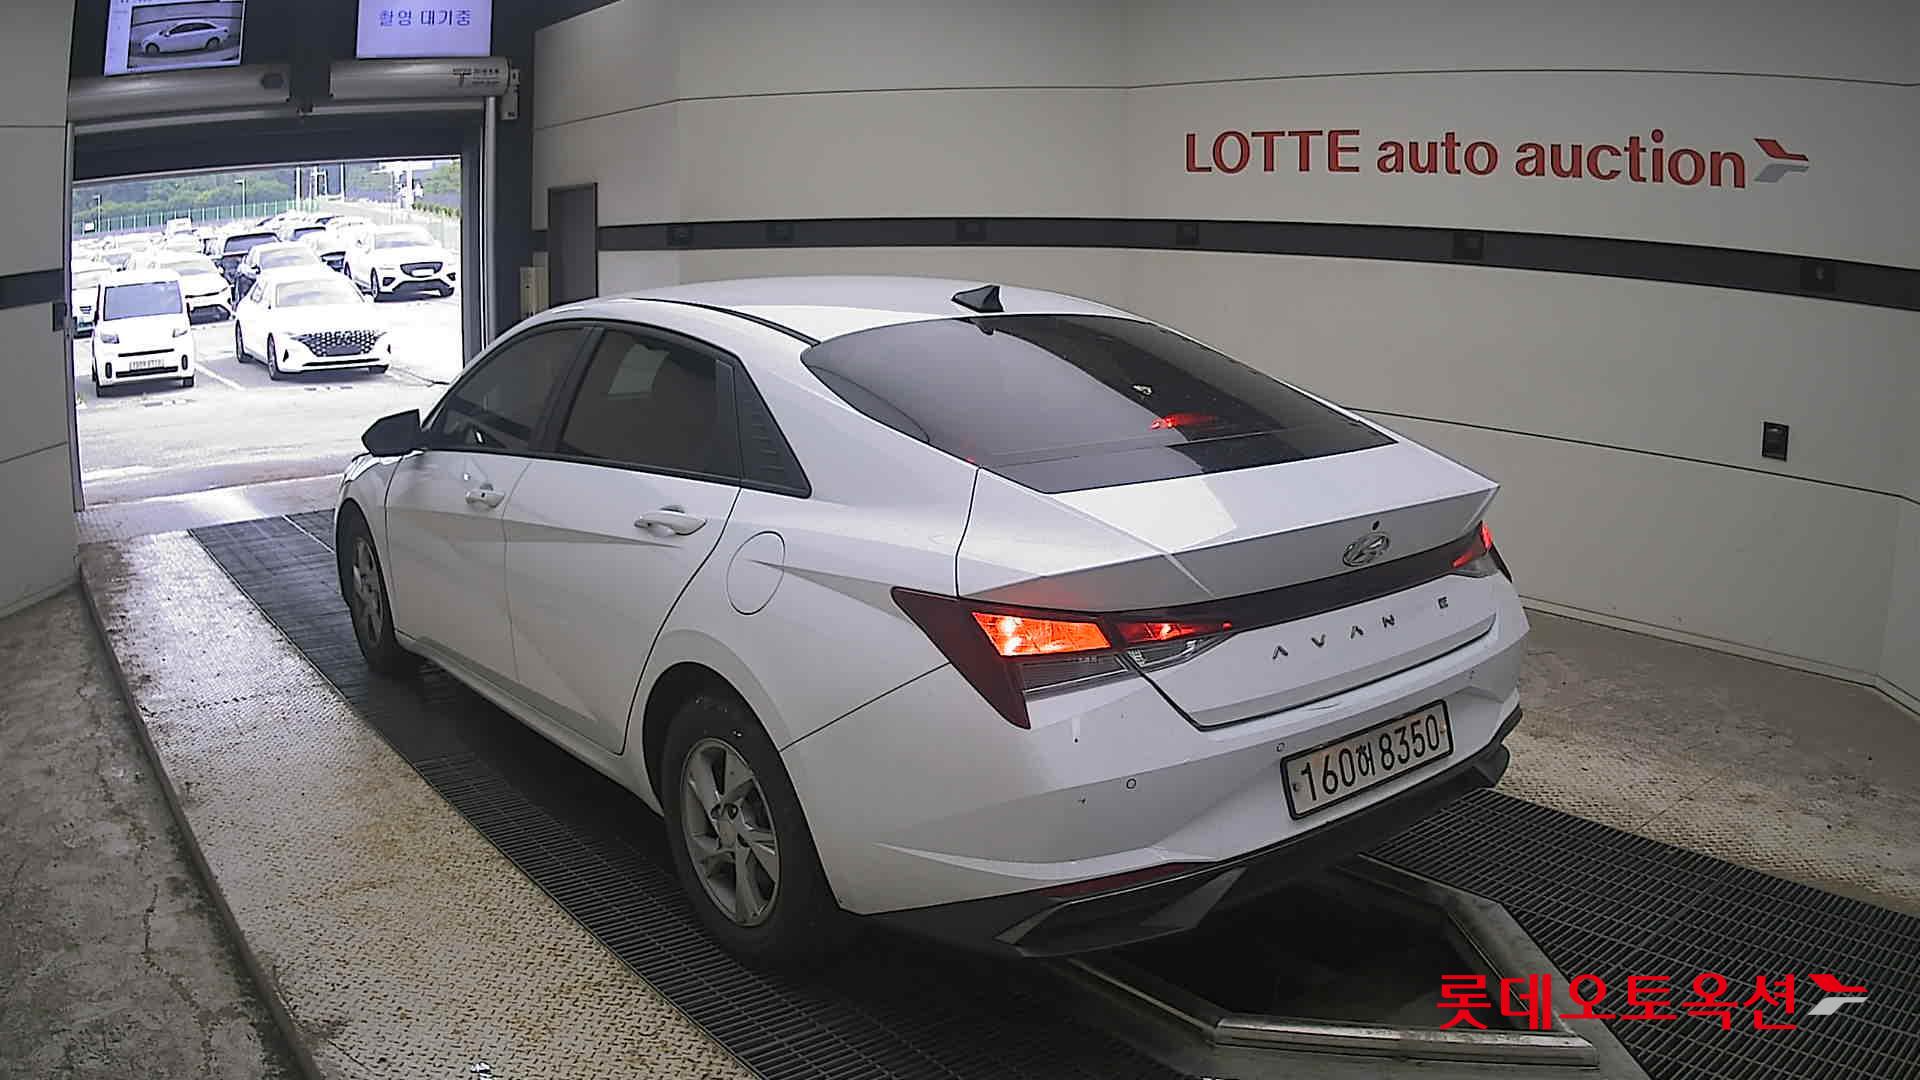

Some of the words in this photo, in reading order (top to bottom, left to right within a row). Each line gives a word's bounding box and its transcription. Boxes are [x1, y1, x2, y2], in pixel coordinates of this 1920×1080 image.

[420, 9, 471, 26] 대기중
[1186, 129, 1360, 174] LOTTE
[1376, 131, 1499, 176] auto
[1515, 128, 1746, 189] auction
